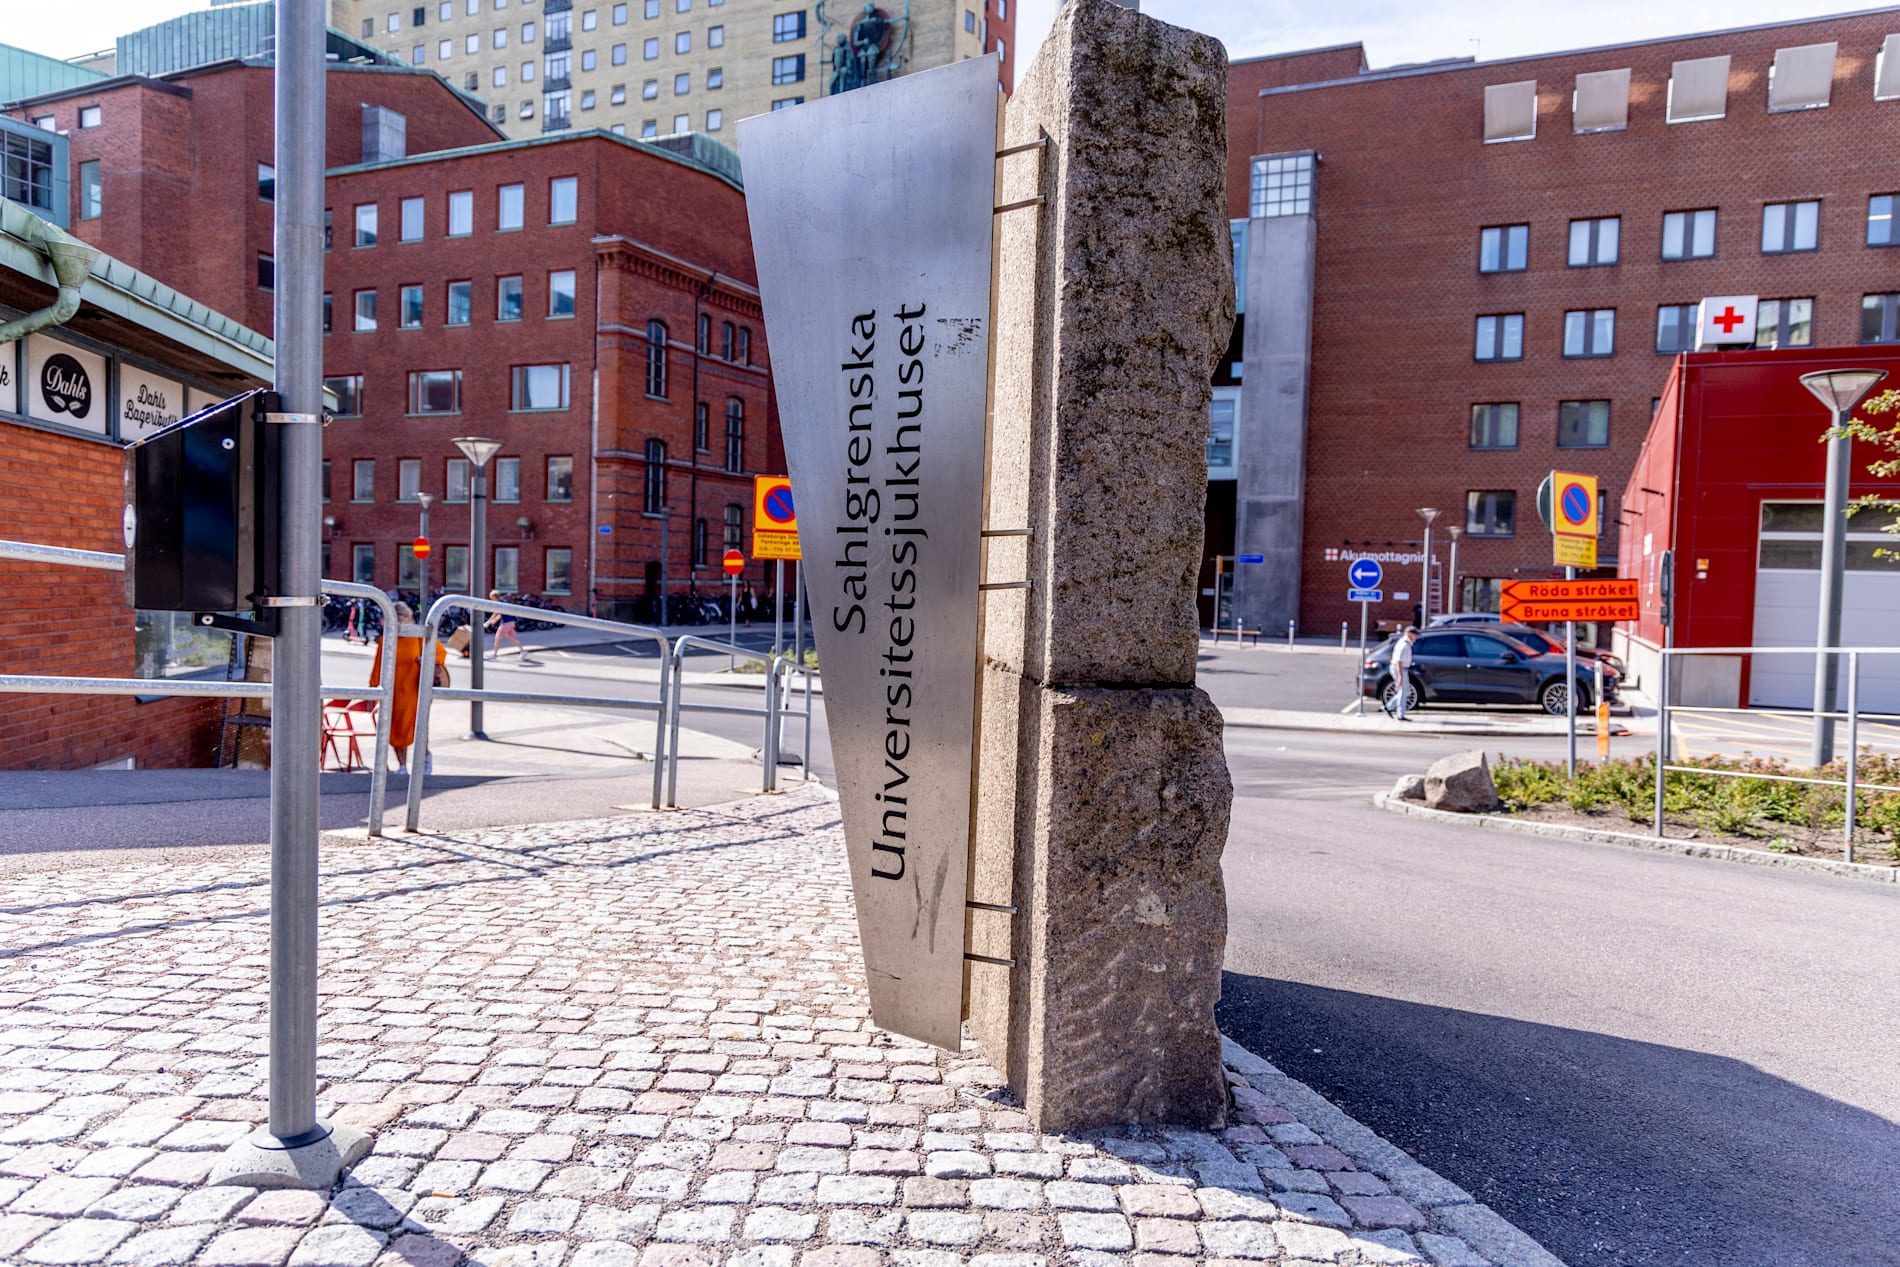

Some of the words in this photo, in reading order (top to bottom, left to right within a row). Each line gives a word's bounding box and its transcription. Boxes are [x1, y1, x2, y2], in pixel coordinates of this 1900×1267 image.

[45, 365, 87, 400] Dahls
[137, 384, 166, 409] Dahls
[833, 308, 881, 634] Sahlgrenska
[871, 302, 929, 881] Universitetssjukhuset
[1530, 585, 1569, 597] Röda
[1576, 584, 1634, 596] stråket
[1524, 606, 1569, 618] Bruna
[1576, 605, 1634, 617] stråket
